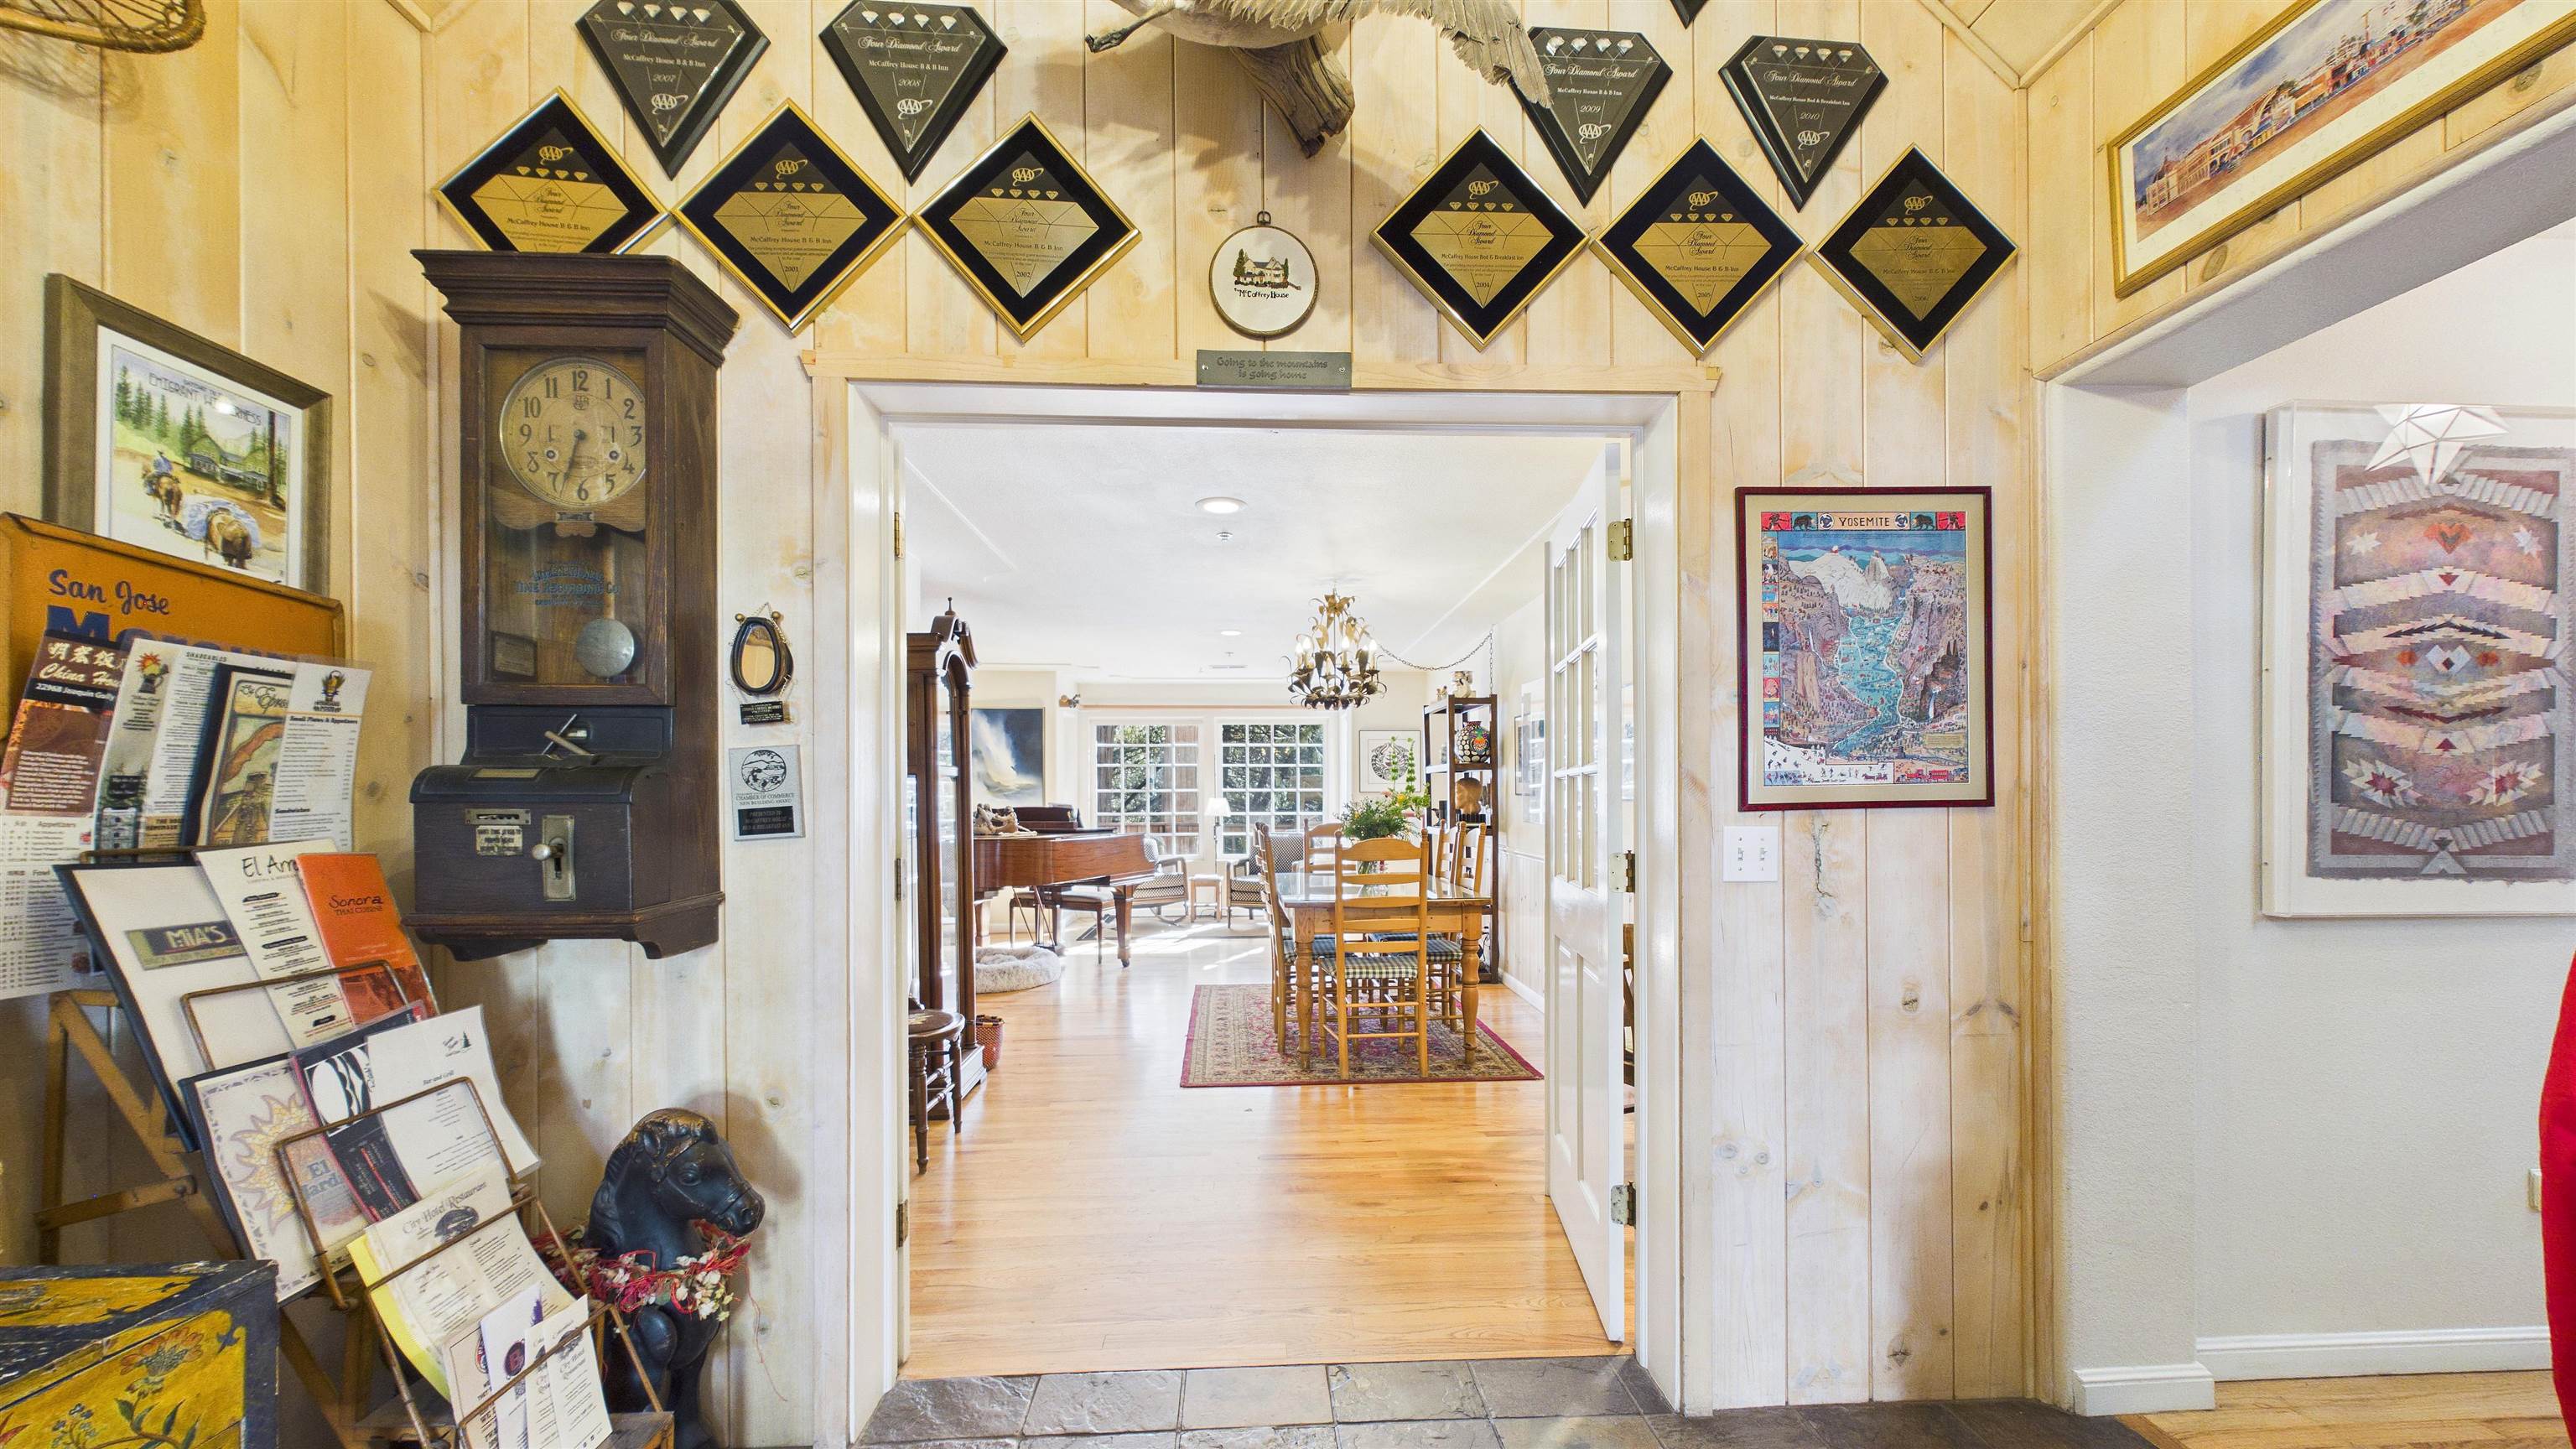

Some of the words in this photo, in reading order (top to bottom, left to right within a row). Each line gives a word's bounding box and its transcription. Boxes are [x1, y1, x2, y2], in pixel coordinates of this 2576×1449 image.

[610, 29, 638, 41] Four
[640, 29, 679, 44] Diamond
[681, 32, 719, 47] Award
[858, 35, 884, 49] Four
[886, 36, 926, 50] Diamond
[926, 38, 963, 53] Award
[623, 54, 654, 65] McCaffrey
[656, 56, 674, 65] House
[869, 60, 898, 69] McCaffrey
[1543, 63, 1566, 75] Four
[1567, 64, 1604, 77] Diamond
[1604, 65, 1639, 79] Award
[1763, 70, 1788, 82] Four
[1788, 71, 1825, 85] Diamond
[1827, 73, 1857, 87] Award
[898, 79, 922, 87] 2008
[1580, 105, 1601, 113] 2009
[1800, 112, 1820, 121] 2010
[1008, 215, 1038, 225] Diamond
[1019, 208, 1035, 216] Four
[1013, 225, 1036, 233] Award
[1467, 228, 1495, 237] Diamond
[1473, 221, 1491, 230] Four
[1469, 236, 1495, 245] Award
[1688, 239, 1717, 247] Diamond
[1693, 231, 1713, 241] Four
[1689, 247, 1716, 256] Award
[1239, 289, 1270, 299] McCaffrey
[1270, 290, 1290, 299] House
[1217, 357, 1245, 369] Going
[1248, 359, 1256, 367] to
[1259, 359, 1275, 368] the
[1277, 361, 1327, 369] mountains
[572, 371, 589, 392] 12
[1239, 369, 1247, 377] is
[1249, 370, 1277, 380] going
[1279, 370, 1307, 379] home
[546, 377, 558, 398] 11
[605, 377, 611, 399] 1
[523, 397, 541, 418] 10
[623, 398, 635, 419] 2
[519, 424, 532, 446] 9
[631, 426, 642, 447] 3
[527, 451, 539, 473] 8
[622, 453, 635, 475] 4
[548, 472, 559, 492] 7
[577, 479, 589, 501] 6
[605, 474, 616, 495] 5
[1839, 517, 1890, 527] YOSEMITE
[49, 569, 106, 603] San
[115, 580, 169, 615] Jose
[39, 662, 86, 683] China
[63, 686, 94, 698] Joaquin
[242, 856, 262, 877] El
[329, 895, 383, 908] Sonora
[308, 1159, 331, 1176] El
[422, 1201, 446, 1222] Hotel
[448, 1182, 486, 1209] Restaurant
